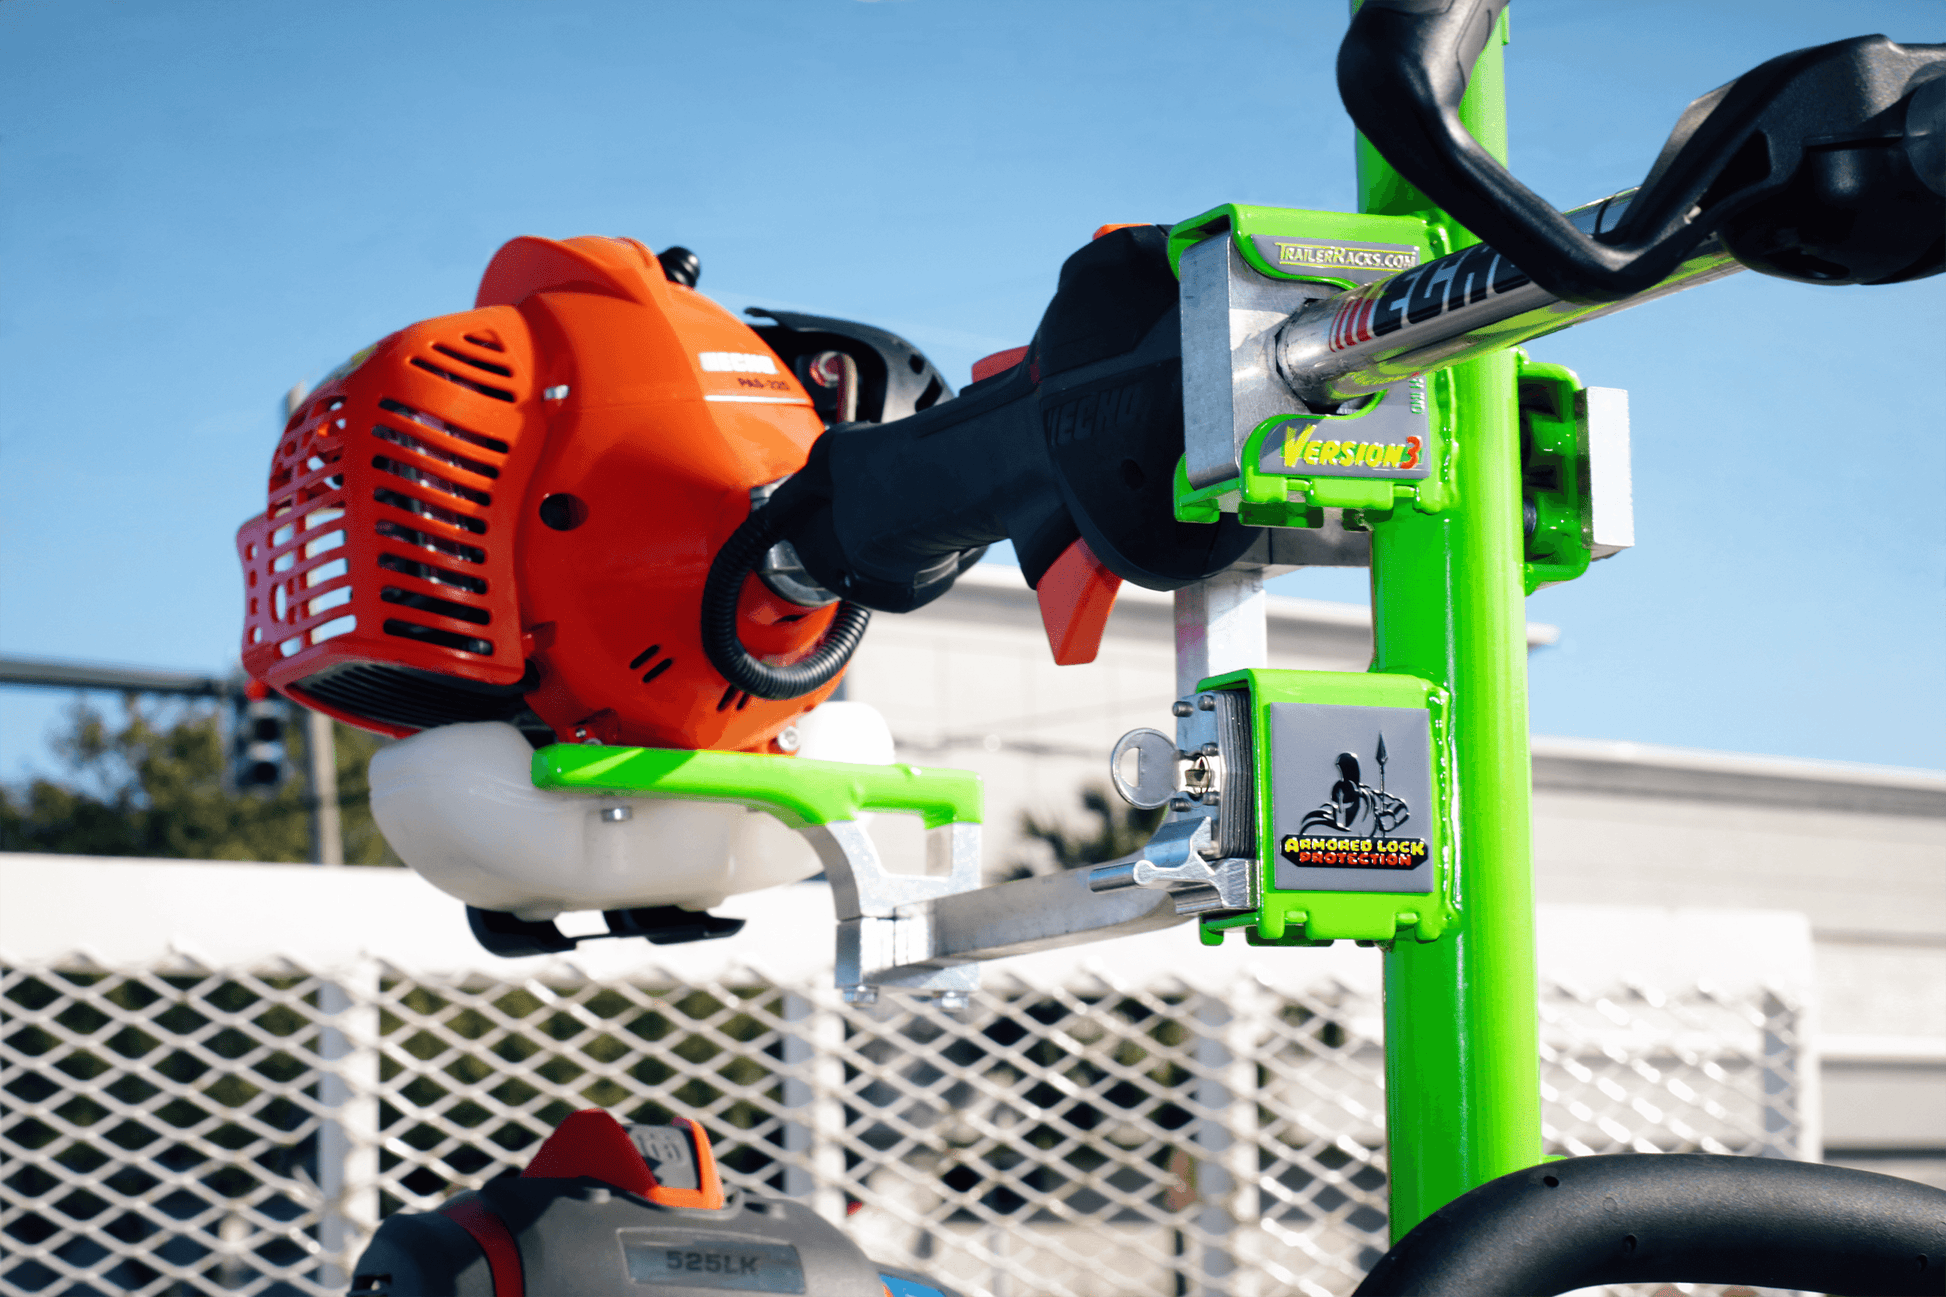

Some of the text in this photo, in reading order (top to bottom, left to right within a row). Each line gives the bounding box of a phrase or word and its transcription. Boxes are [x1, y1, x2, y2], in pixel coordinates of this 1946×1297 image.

[1285, 837, 1425, 856] ARMORED LOCK
[1299, 852, 1412, 866] PROTECTION
[666, 1250, 757, 1274] 525LK
